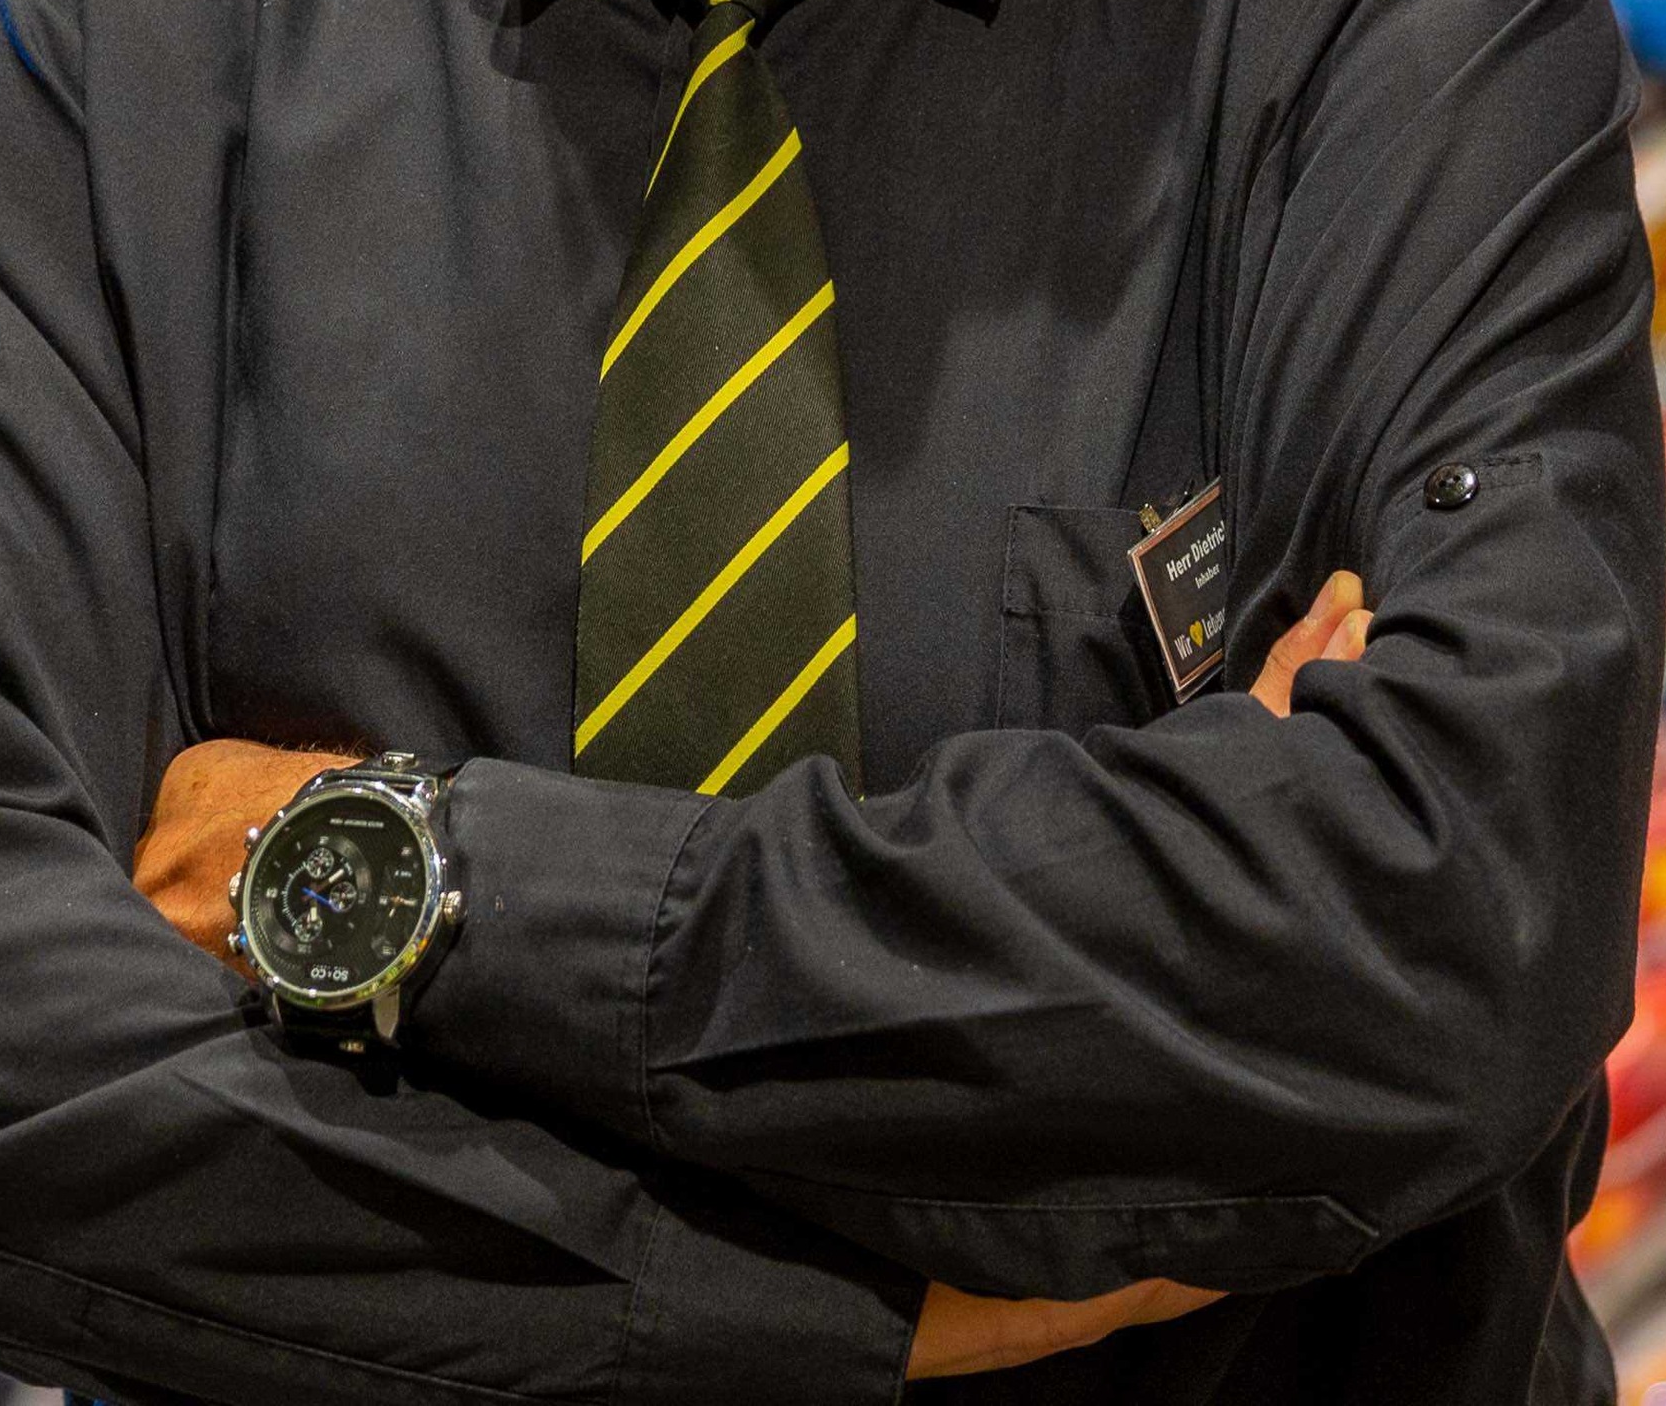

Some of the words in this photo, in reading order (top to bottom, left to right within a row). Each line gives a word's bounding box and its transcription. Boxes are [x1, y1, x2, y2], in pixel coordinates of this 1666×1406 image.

[1166, 550, 1192, 582] Herr
[1194, 563, 1221, 589] Inhaber
[1174, 634, 1192, 661] Wir
